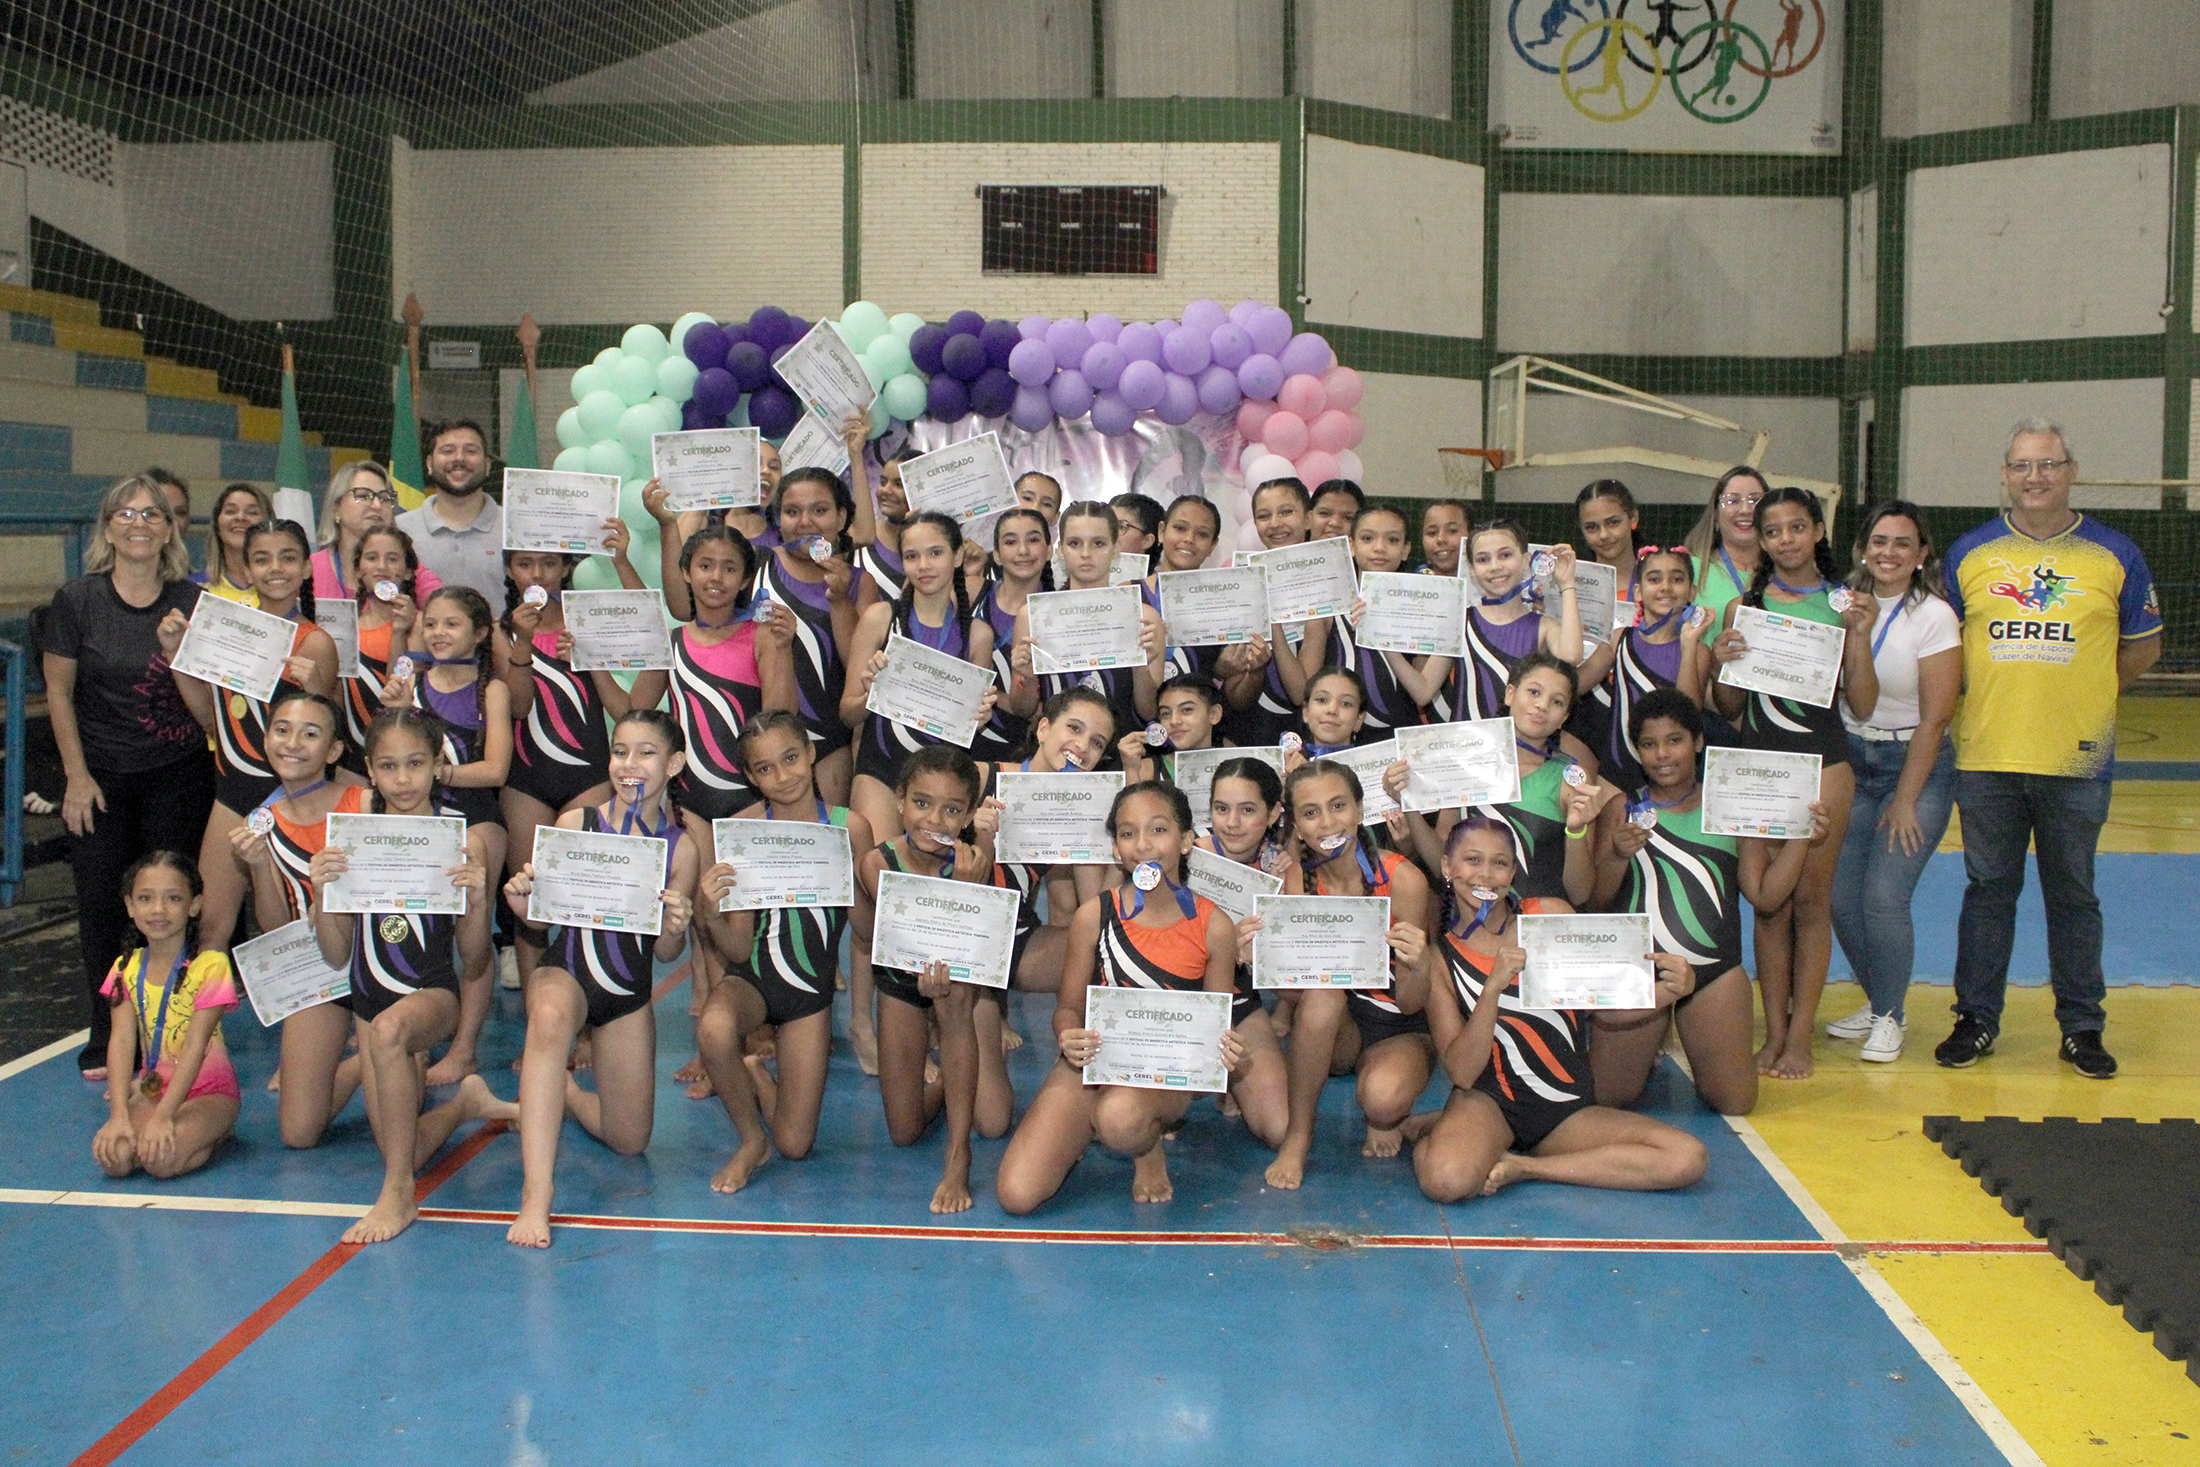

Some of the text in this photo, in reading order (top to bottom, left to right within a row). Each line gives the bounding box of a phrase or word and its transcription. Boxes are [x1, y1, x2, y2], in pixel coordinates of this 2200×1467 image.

[829, 350, 859, 388] CERTIFICADO
[682, 446, 731, 456] CERTIFICADO
[785, 431, 813, 467] CERTIFICADO
[927, 456, 974, 477] CERTIFICADO
[535, 487, 589, 498] CERTIFICADO
[1276, 557, 1325, 571] CERTIFICADO
[1189, 583, 1240, 593] CERTIFICADO
[1388, 589, 1439, 599] CERTIFICADO
[589, 607, 638, 616] CERTIFICADO
[1059, 604, 1112, 615] CERTIFICADO
[221, 617, 267, 638] CERTIFICADO
[1989, 620, 2076, 642] GEREL
[1989, 643, 2023, 651] Gerência
[2041, 644, 2075, 653] Esporte
[913, 661, 963, 685] CERTIFICADO
[1752, 666, 1804, 684] CERTIFICADO
[1429, 739, 1484, 750] CERTIFICADO
[1736, 768, 1790, 778] CERTIFICADO
[1032, 792, 1092, 801] CERTIFICADO
[364, 836, 429, 845] CERTIFICADO
[752, 836, 815, 845] CERTIFICADO
[566, 851, 630, 864] CERTIFICADO
[916, 897, 980, 914] CERTIFICADO
[1290, 915, 1353, 923] CERTIFICADO
[1555, 934, 1617, 943] CERTIFICADO
[1126, 1009, 1193, 1022] CERTIFICADO
